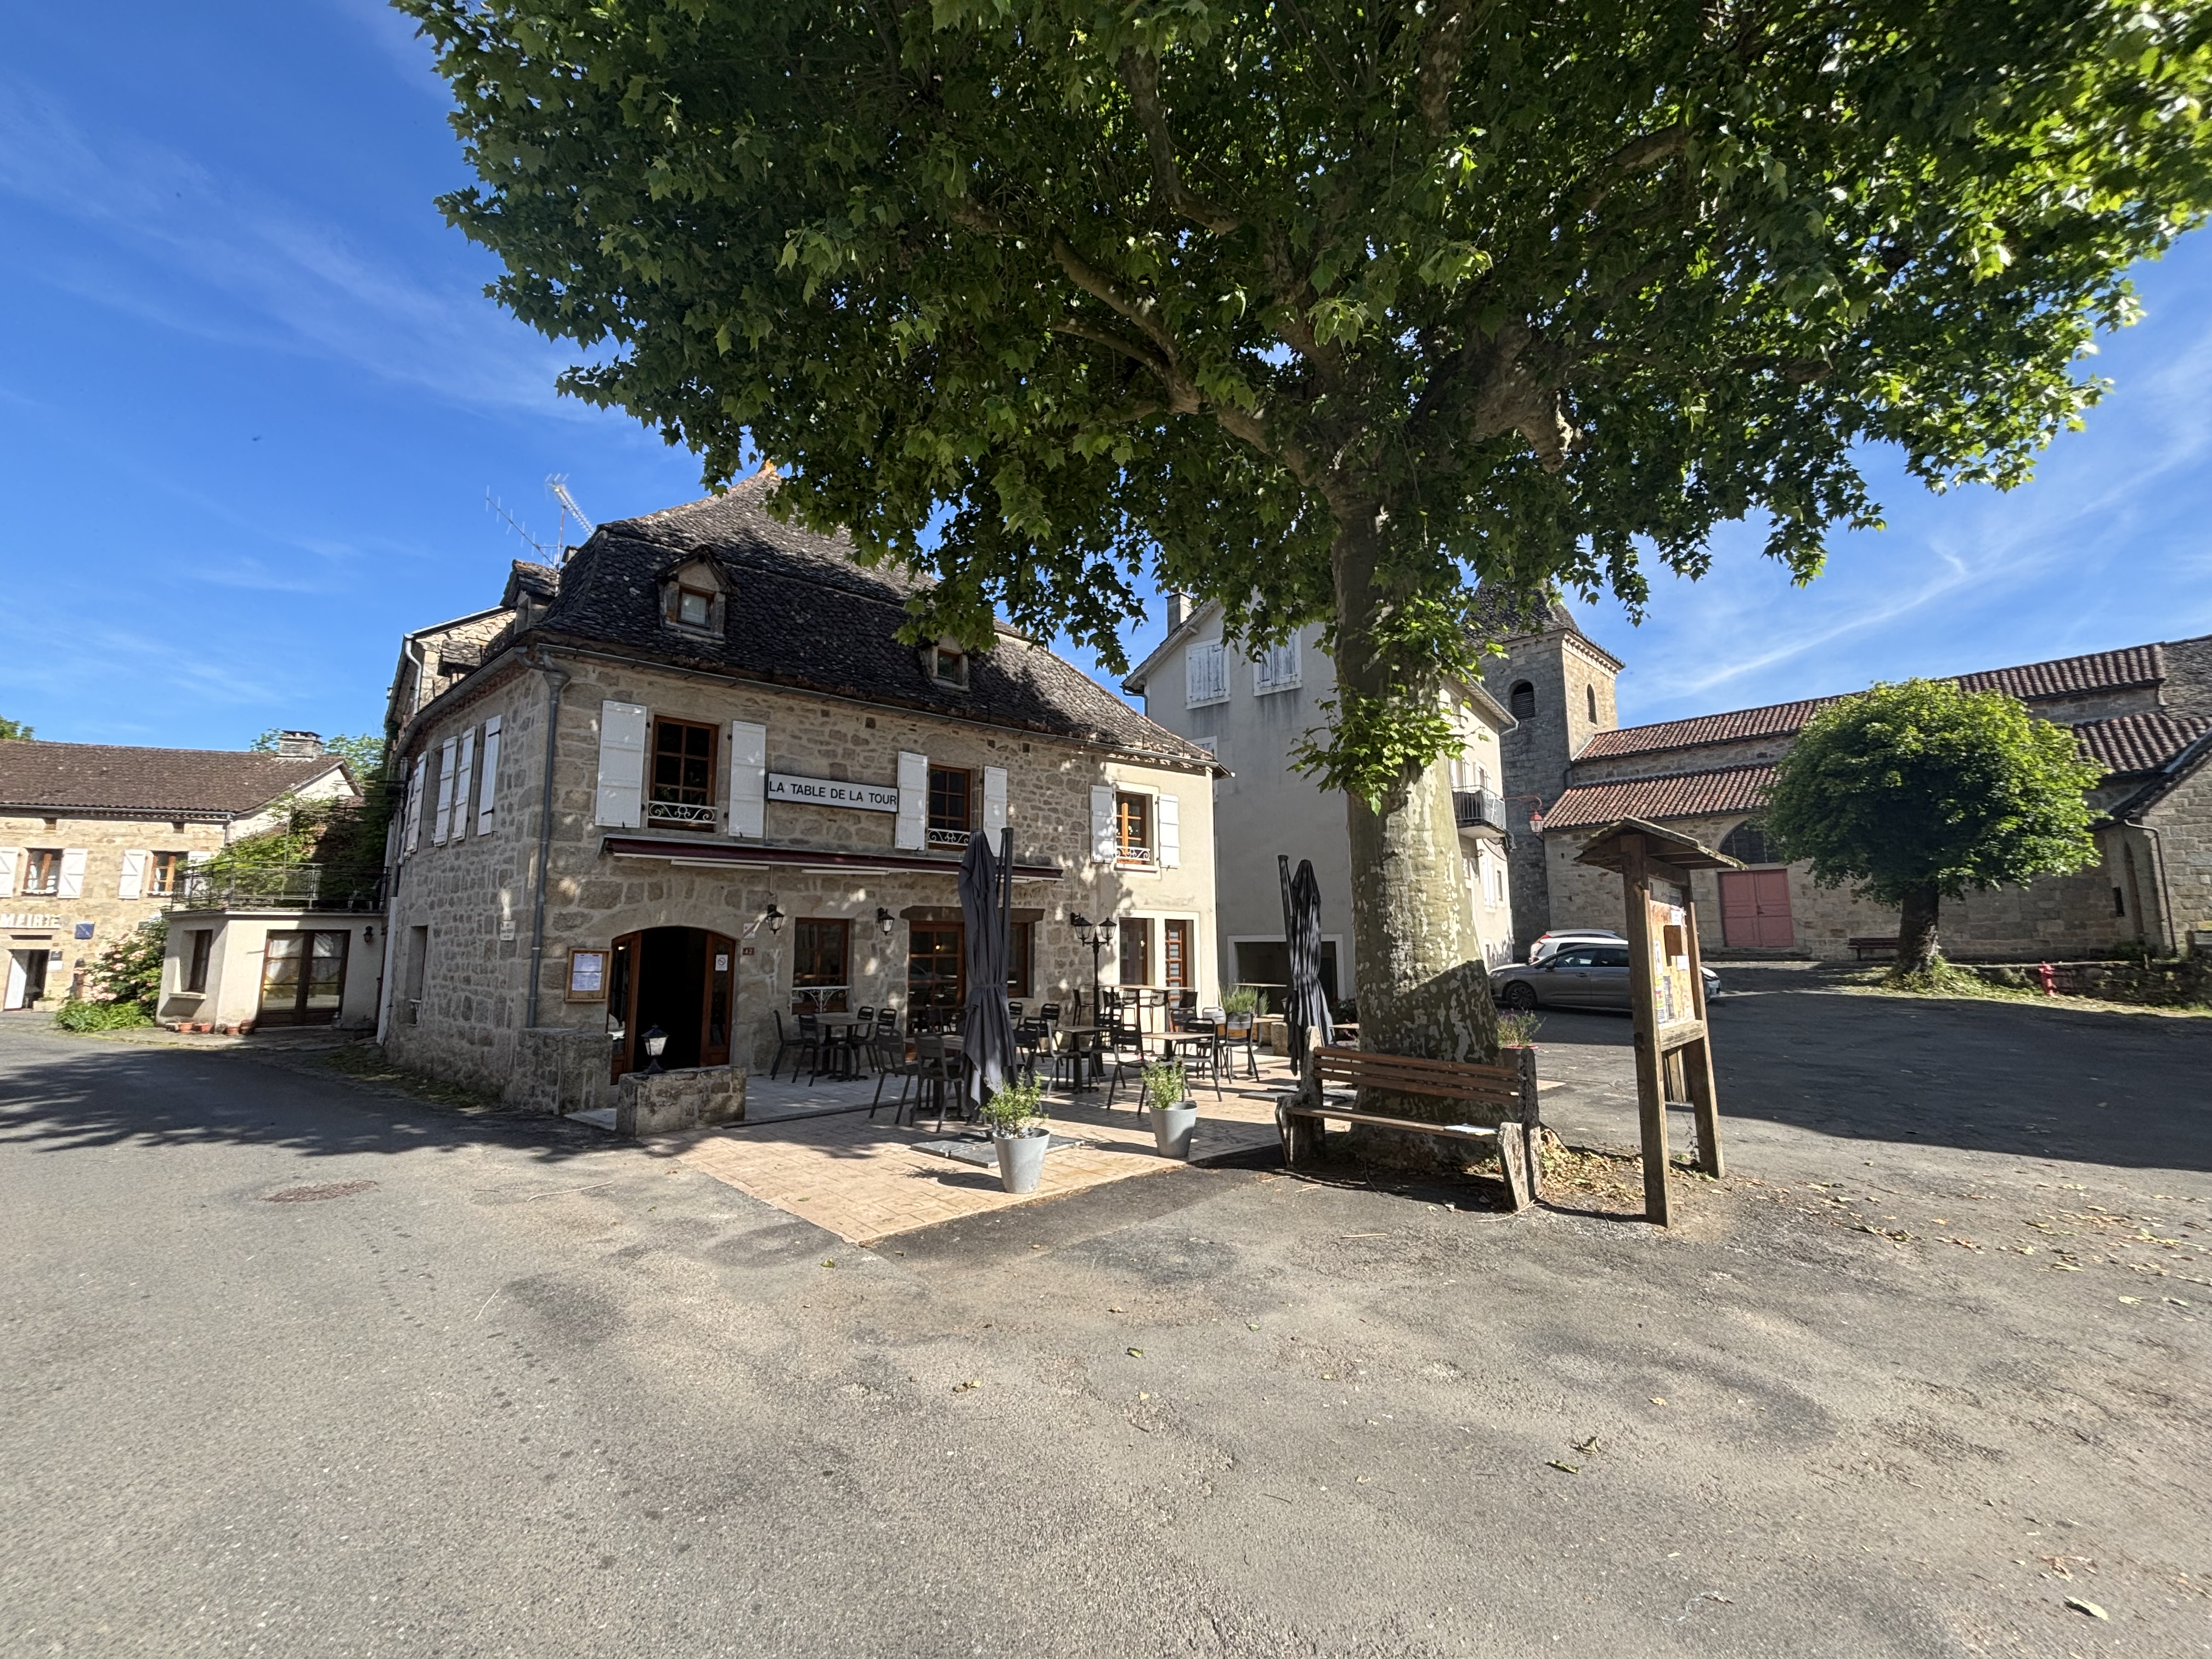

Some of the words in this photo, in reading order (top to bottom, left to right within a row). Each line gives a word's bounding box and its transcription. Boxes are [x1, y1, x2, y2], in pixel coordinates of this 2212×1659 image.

[769, 781, 785, 793] LA
[791, 783, 826, 798] TABLE
[831, 788, 845, 799] DE
[849, 791, 864, 802] LA
[868, 793, 896, 805] TOUR
[0, 913, 60, 928] MAIRIE
